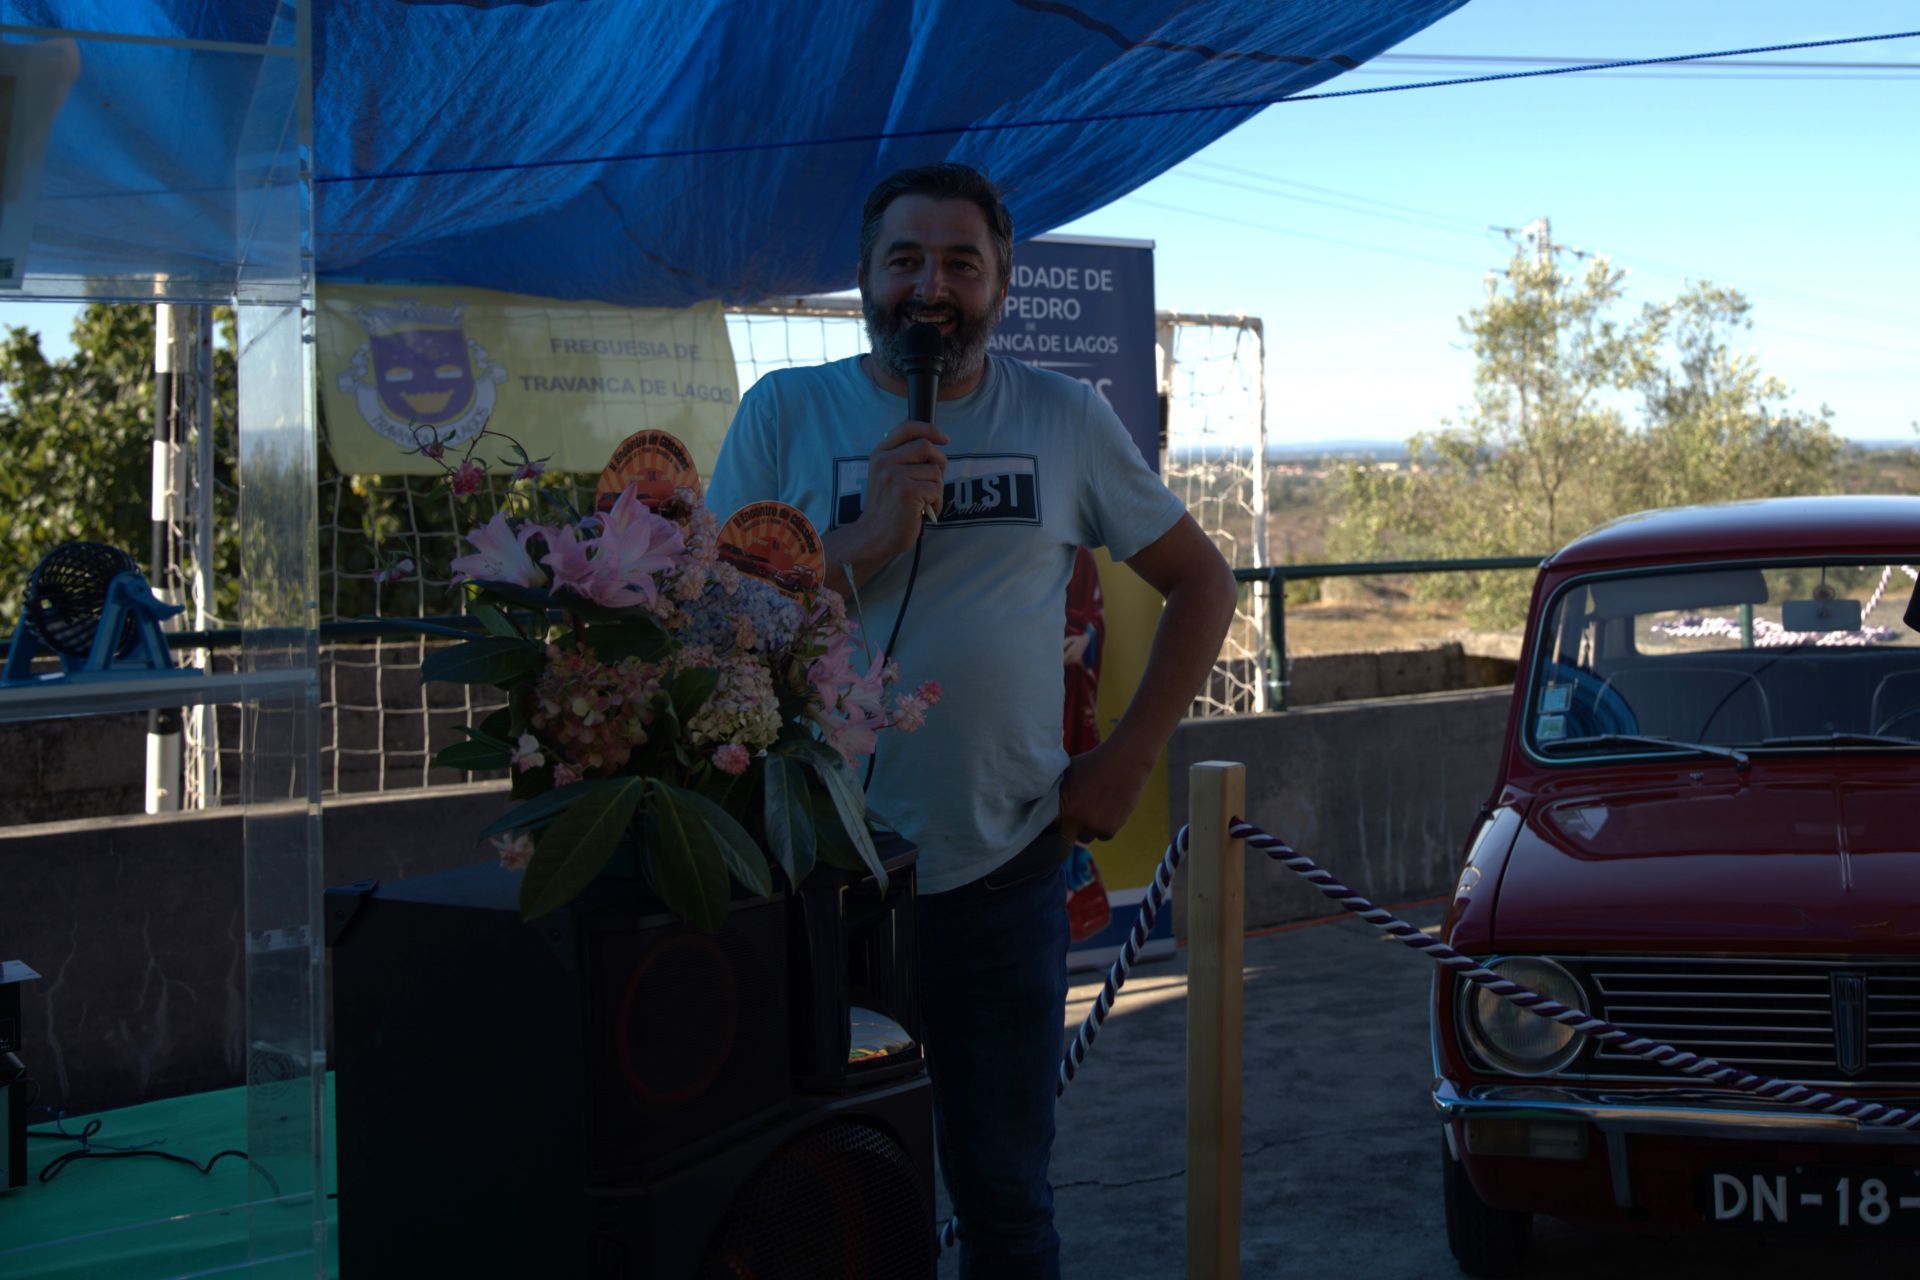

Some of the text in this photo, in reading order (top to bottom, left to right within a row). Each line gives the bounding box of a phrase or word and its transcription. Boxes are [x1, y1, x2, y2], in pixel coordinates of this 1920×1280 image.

[1084, 268, 1114, 292] DE
[1004, 295, 1081, 321] PEDRO
[550, 337, 701, 360] FREGUESIA DE
[1038, 334, 1061, 352] DE
[1065, 336, 1119, 354] LAGOS
[519, 374, 733, 404] TRAVANCA DE LAGOS
